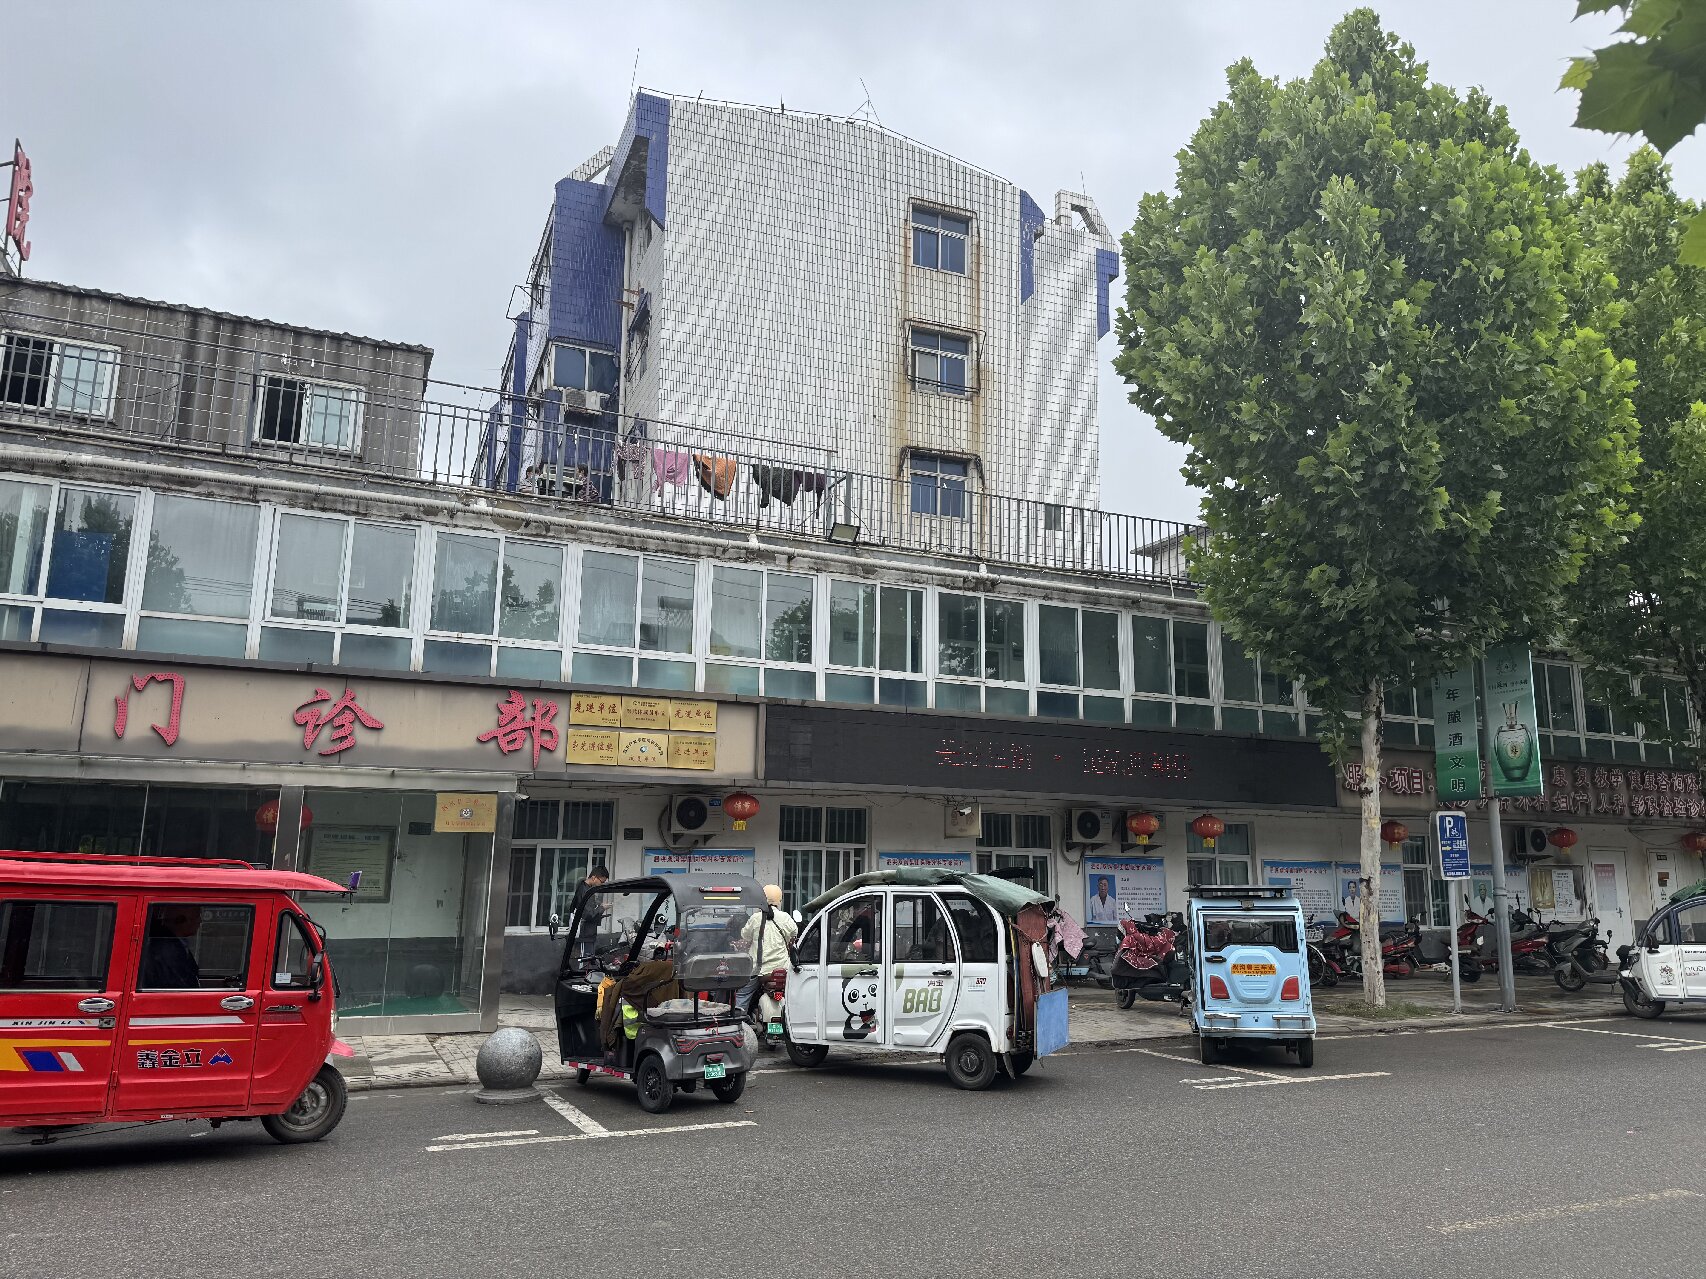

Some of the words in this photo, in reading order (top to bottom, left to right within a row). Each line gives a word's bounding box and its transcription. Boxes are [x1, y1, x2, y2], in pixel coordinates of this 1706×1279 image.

[574, 702, 618, 715] 先进单位
[674, 708, 713, 720] 先进单位
[114, 672, 559, 769] 门诊部
[1345, 763, 1435, 795] 服项目:
[1445, 816, 1454, 838] P
[136, 1048, 203, 1069] 鑫金立
